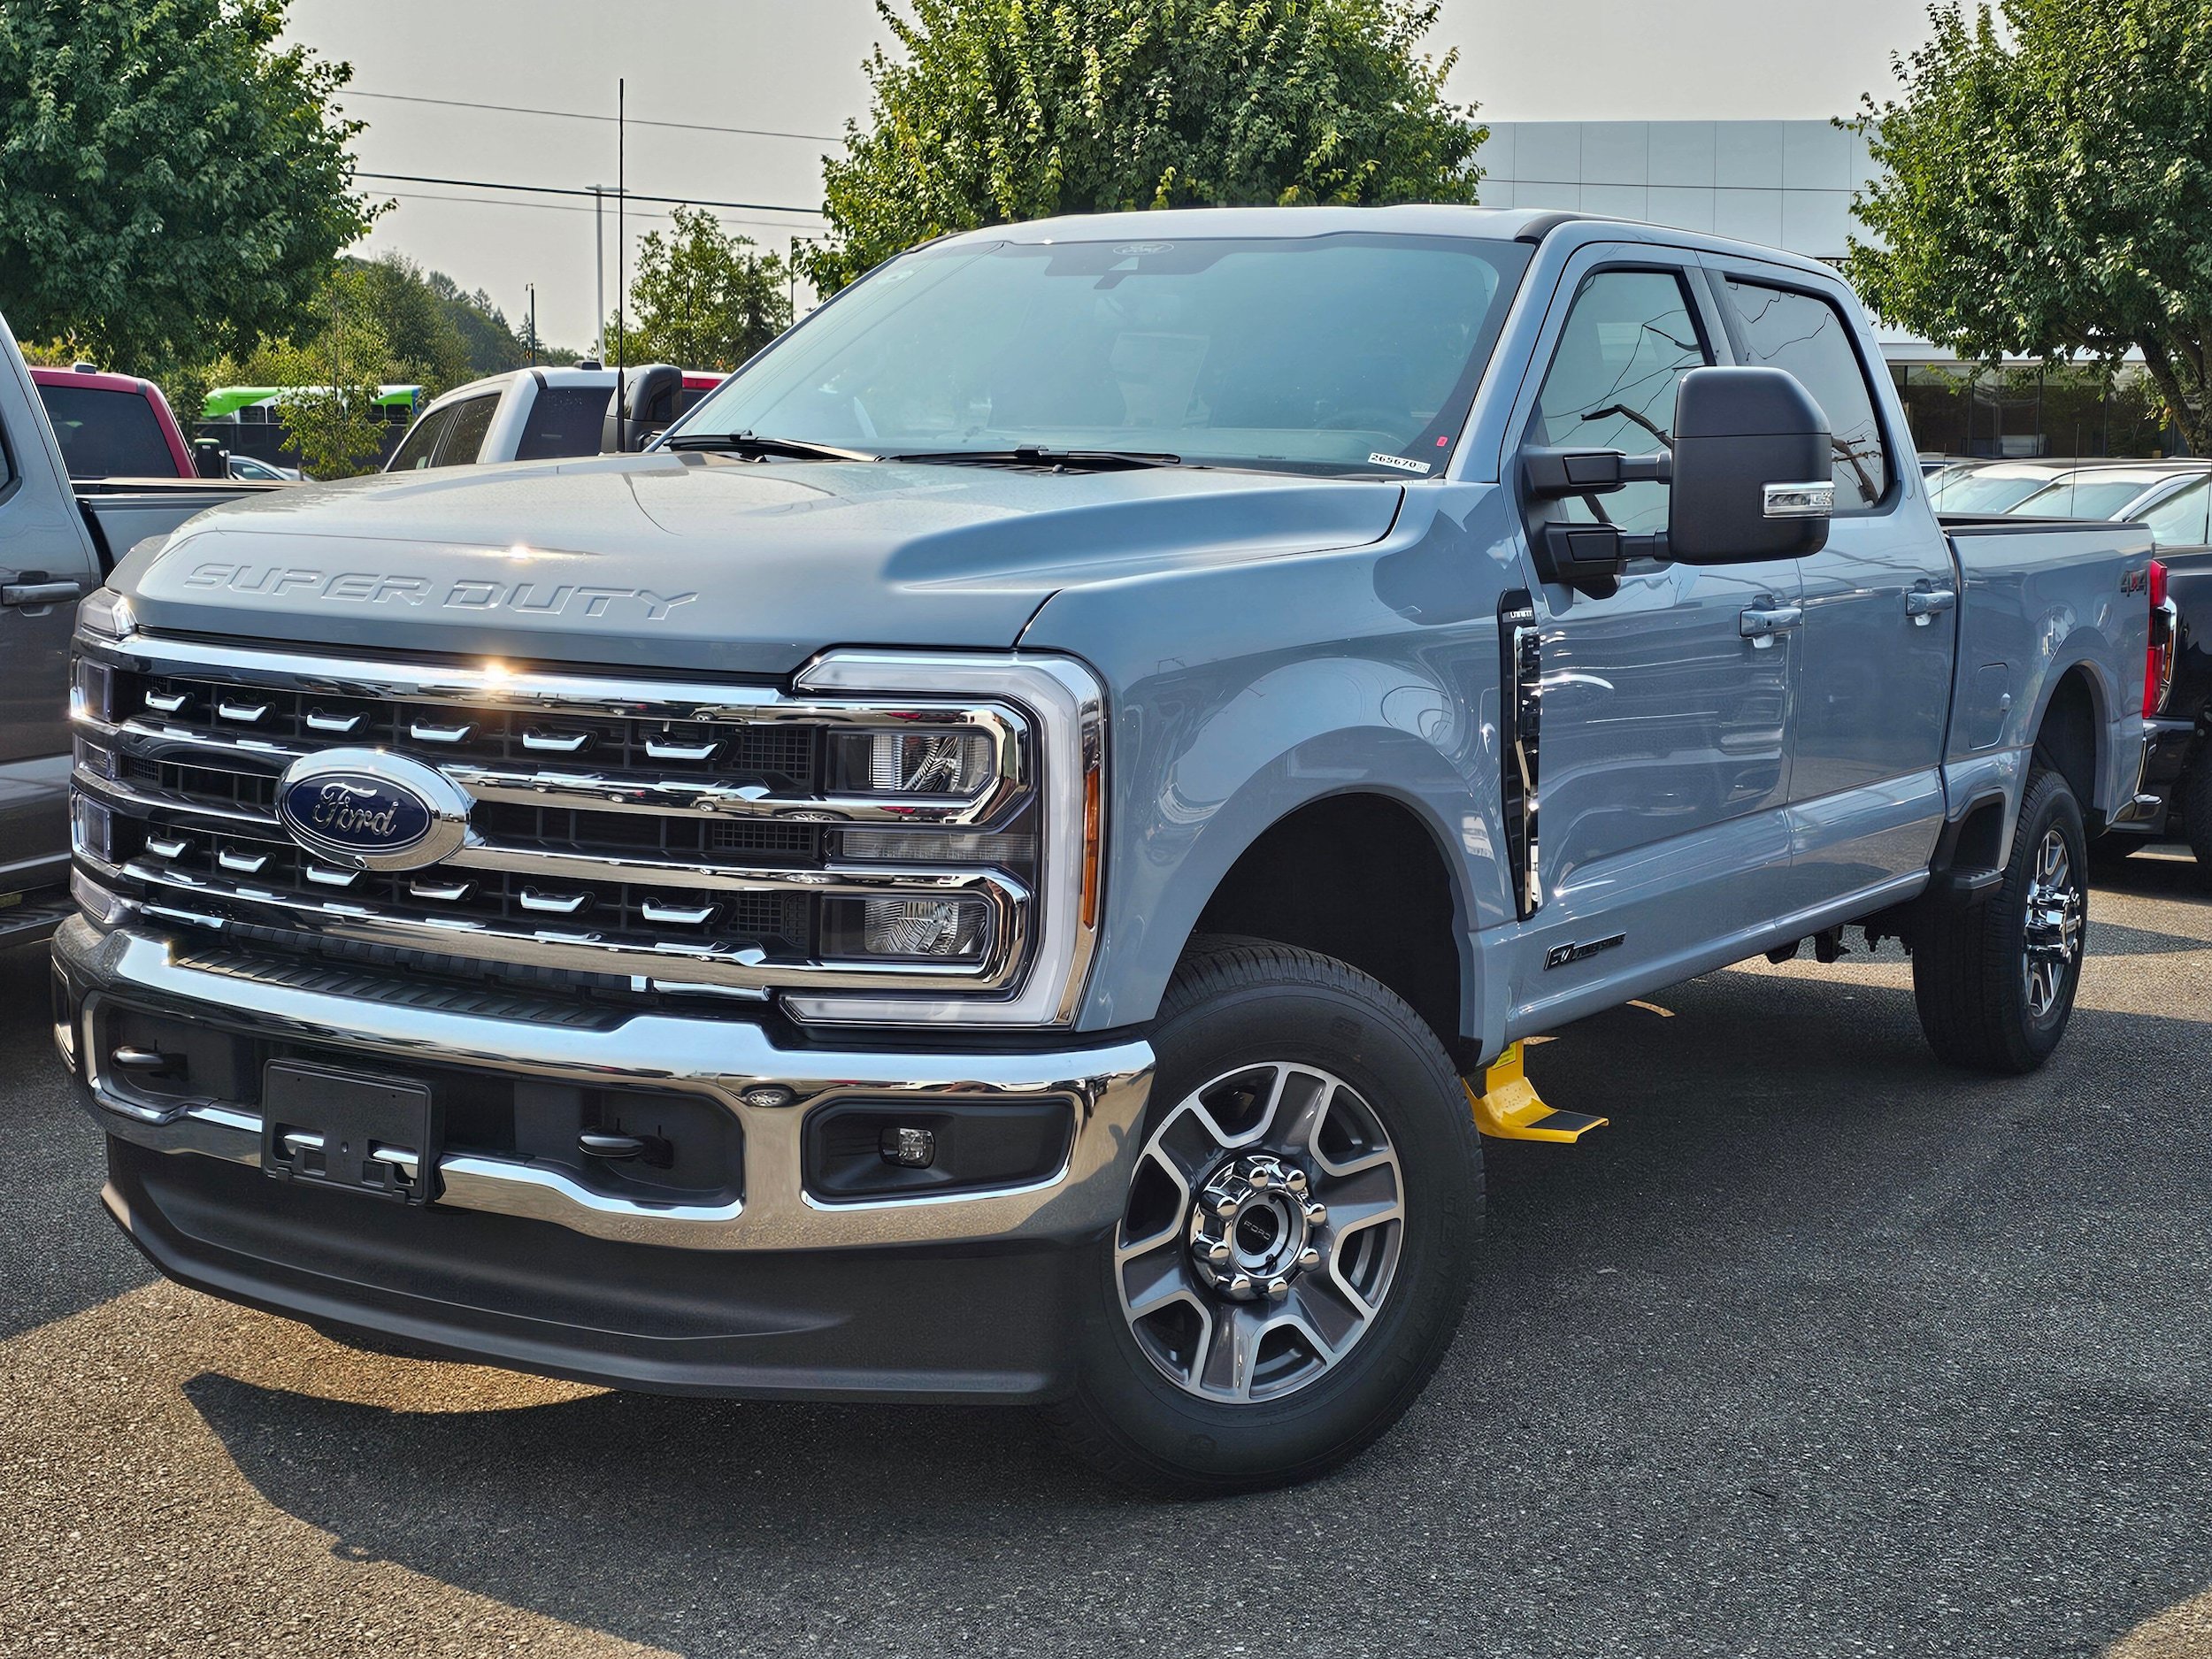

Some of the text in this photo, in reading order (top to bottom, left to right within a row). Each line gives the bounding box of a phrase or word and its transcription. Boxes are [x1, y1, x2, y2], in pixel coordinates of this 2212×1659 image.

[183, 563, 699, 620] SUPER DUTY
[312, 782, 399, 837] Ford
[1244, 1221, 1271, 1240] FORD
